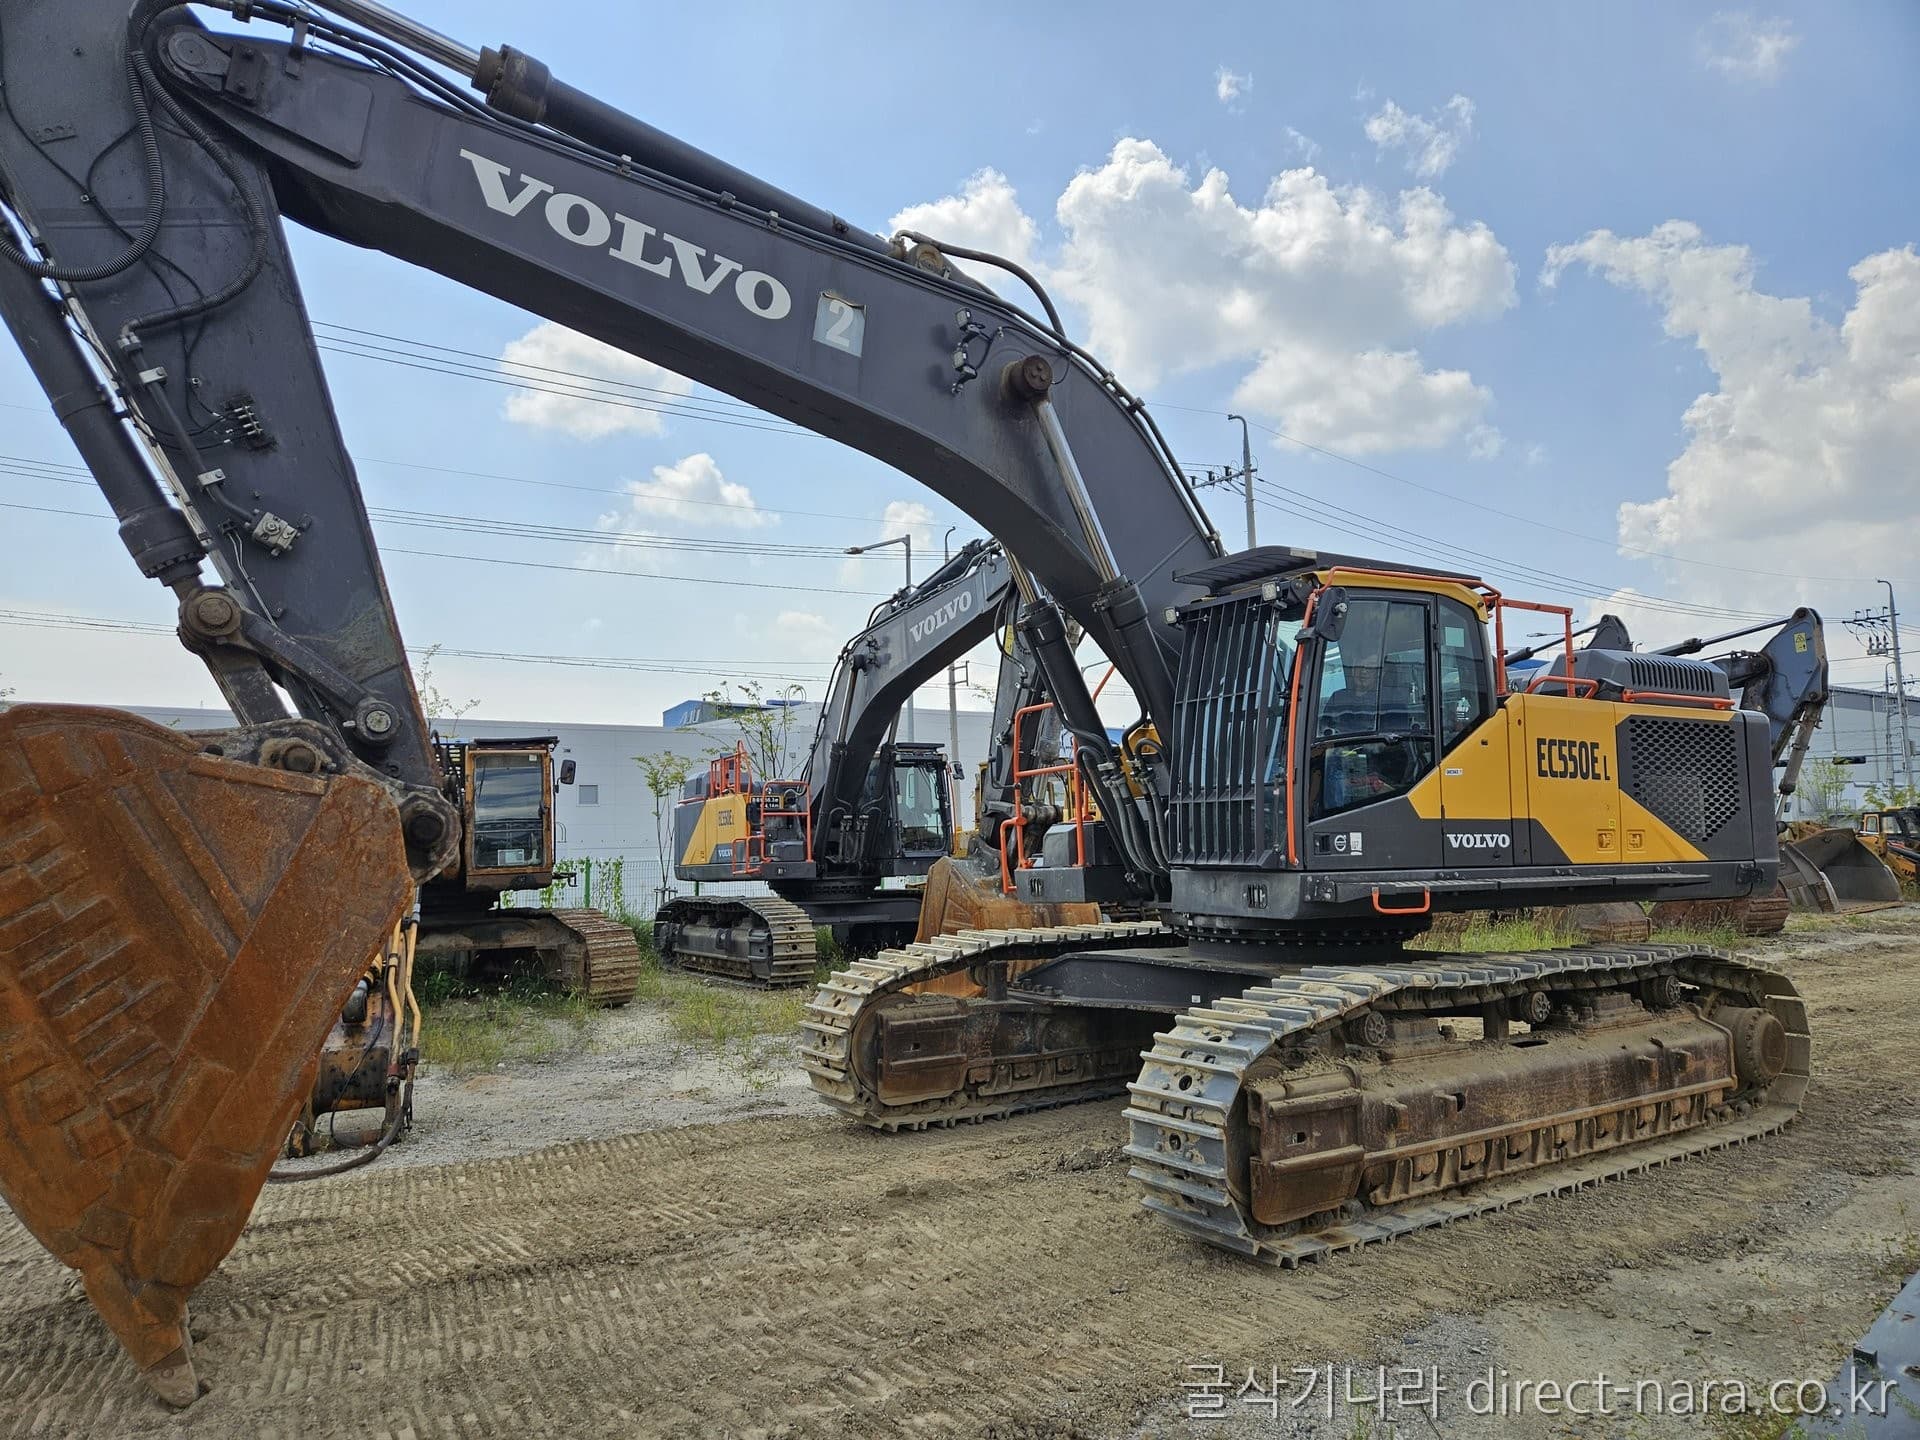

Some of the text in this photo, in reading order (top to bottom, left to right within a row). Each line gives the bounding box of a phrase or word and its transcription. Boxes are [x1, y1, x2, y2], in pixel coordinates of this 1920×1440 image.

[460, 148, 791, 320] VOLVO
[825, 299, 854, 347] 2
[909, 591, 972, 642] VOLVO
[1446, 833, 1511, 848] VOLVO
